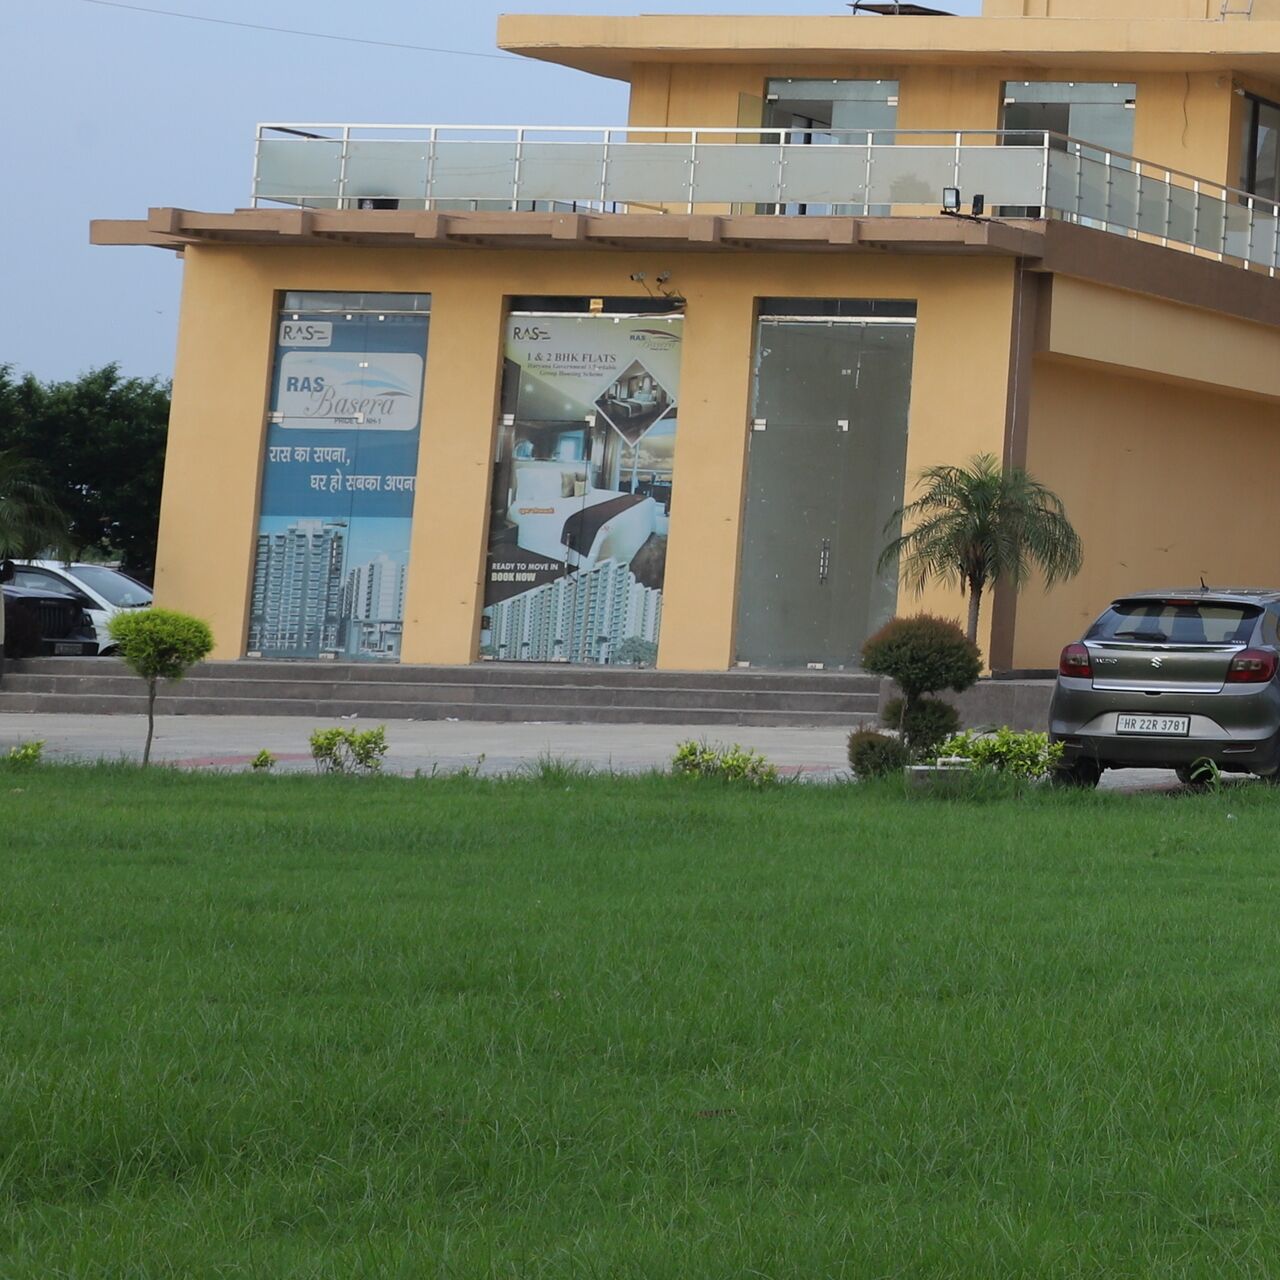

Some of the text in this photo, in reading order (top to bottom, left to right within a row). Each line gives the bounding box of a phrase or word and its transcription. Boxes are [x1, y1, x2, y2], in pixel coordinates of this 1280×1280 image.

[554, 352, 578, 362] BHK
[581, 353, 617, 363] FLATS
[286, 376, 325, 393] RAS
[304, 384, 395, 417] Basera
[269, 446, 350, 466] रास का सपना,
[310, 474, 327, 490] घर
[329, 468, 342, 493] हो
[345, 475, 381, 492] सबका
[491, 562, 559, 571] READY TO MOVE IN
[491, 572, 537, 582] BOOK NOW
[1124, 719, 1185, 731] HR 22R 3781
